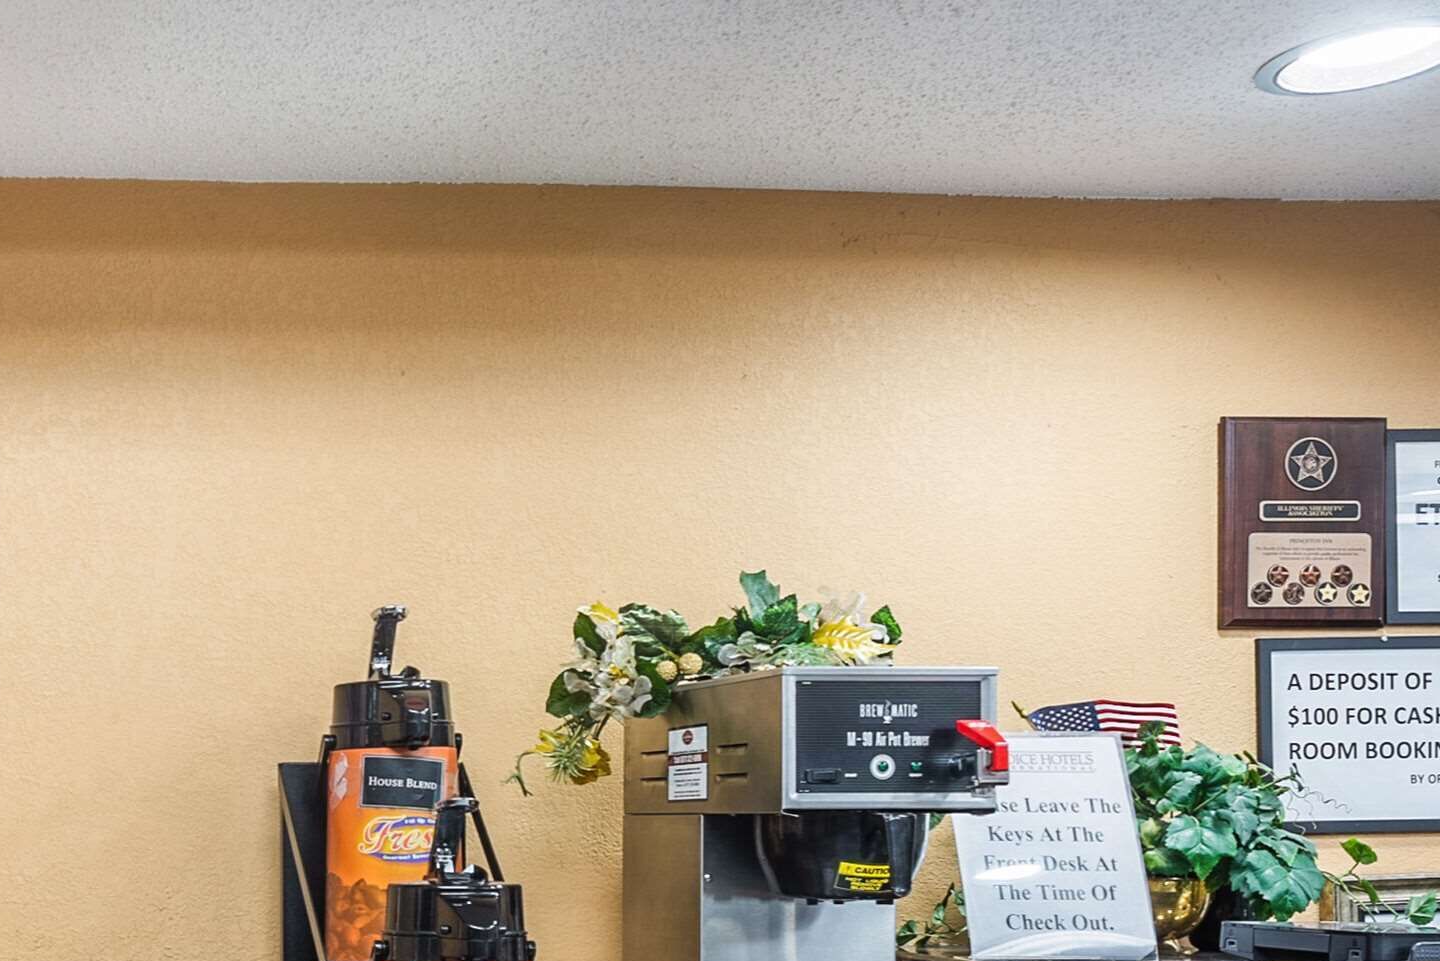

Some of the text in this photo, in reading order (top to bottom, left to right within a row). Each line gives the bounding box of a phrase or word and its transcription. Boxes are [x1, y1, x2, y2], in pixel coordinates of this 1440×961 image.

[1288, 673, 1432, 690] A DEPOSIT OF
[1288, 706, 1338, 728] $100
[1346, 707, 1387, 725] FOR
[1289, 742, 1357, 759] ROOM
[1040, 754, 1095, 766] HOTELS
[368, 775, 437, 790] HOUSE BLEND
[1410, 774, 1440, 784] BY O
[1024, 798, 1080, 813] Leave
[1084, 798, 1122, 814] The
[358, 815, 433, 854] Fres
[987, 826, 1104, 846] Keys At The
[854, 866, 889, 875] CAUTIO
[1042, 855, 1090, 872] Desk
[1095, 857, 1119, 872] At
[993, 884, 1117, 900] The Time Of
[1006, 913, 1114, 930] Check Out.
